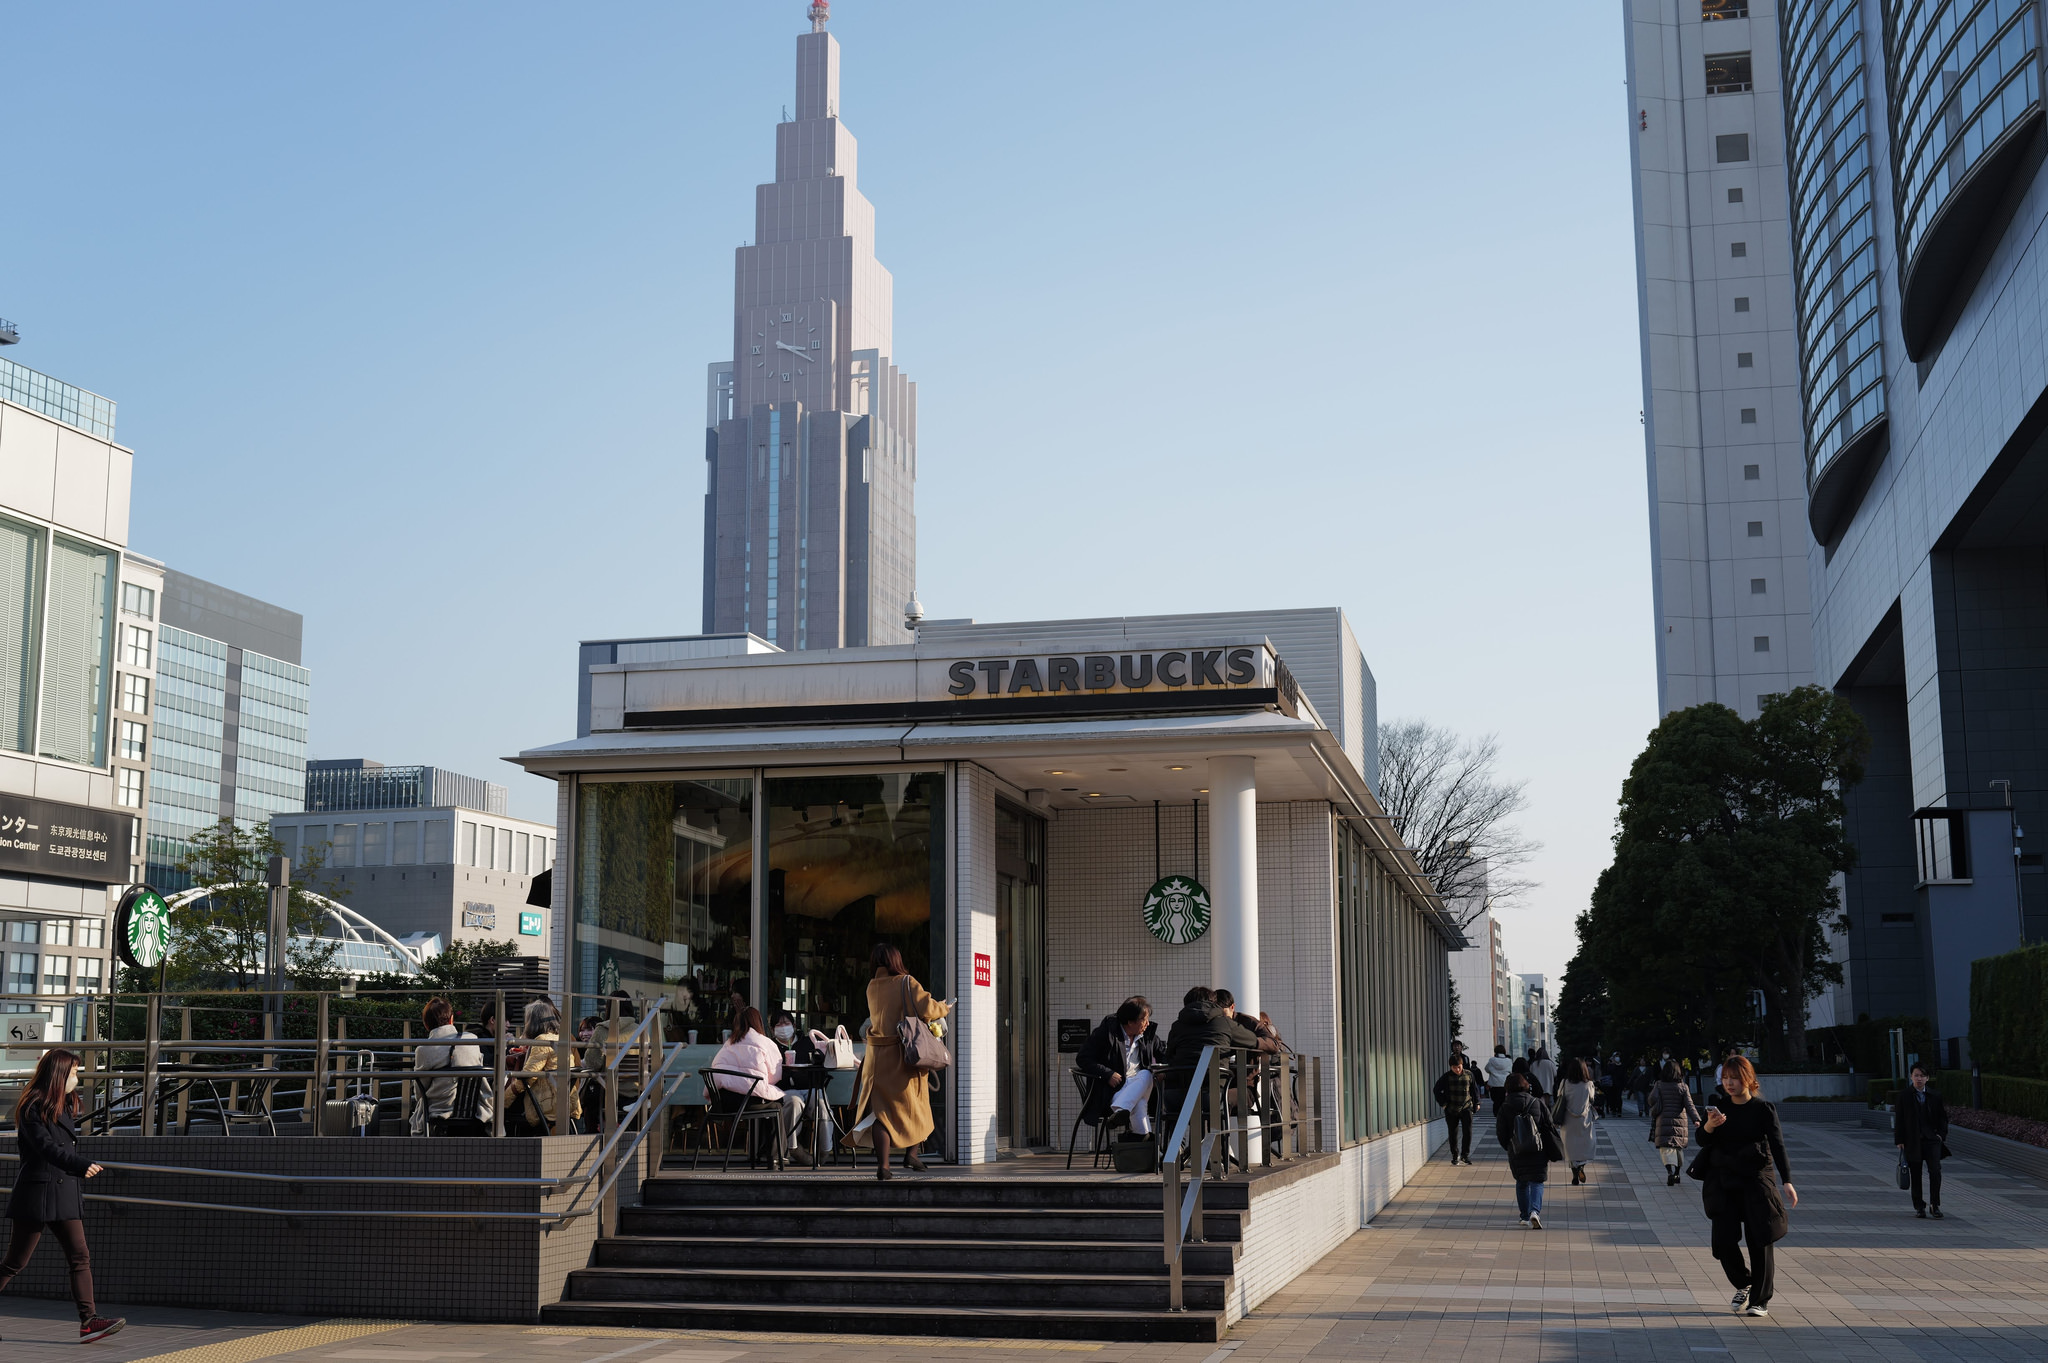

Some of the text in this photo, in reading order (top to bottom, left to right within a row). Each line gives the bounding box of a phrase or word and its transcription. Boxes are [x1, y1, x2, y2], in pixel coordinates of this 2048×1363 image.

[948, 649, 1256, 697] STARBUCKS
[1, 815, 39, 834] ンター
[50, 824, 108, 843] 东京观光信息中心
[0, 836, 40, 852] ion Center
[523, 916, 541, 932] ニトリ
